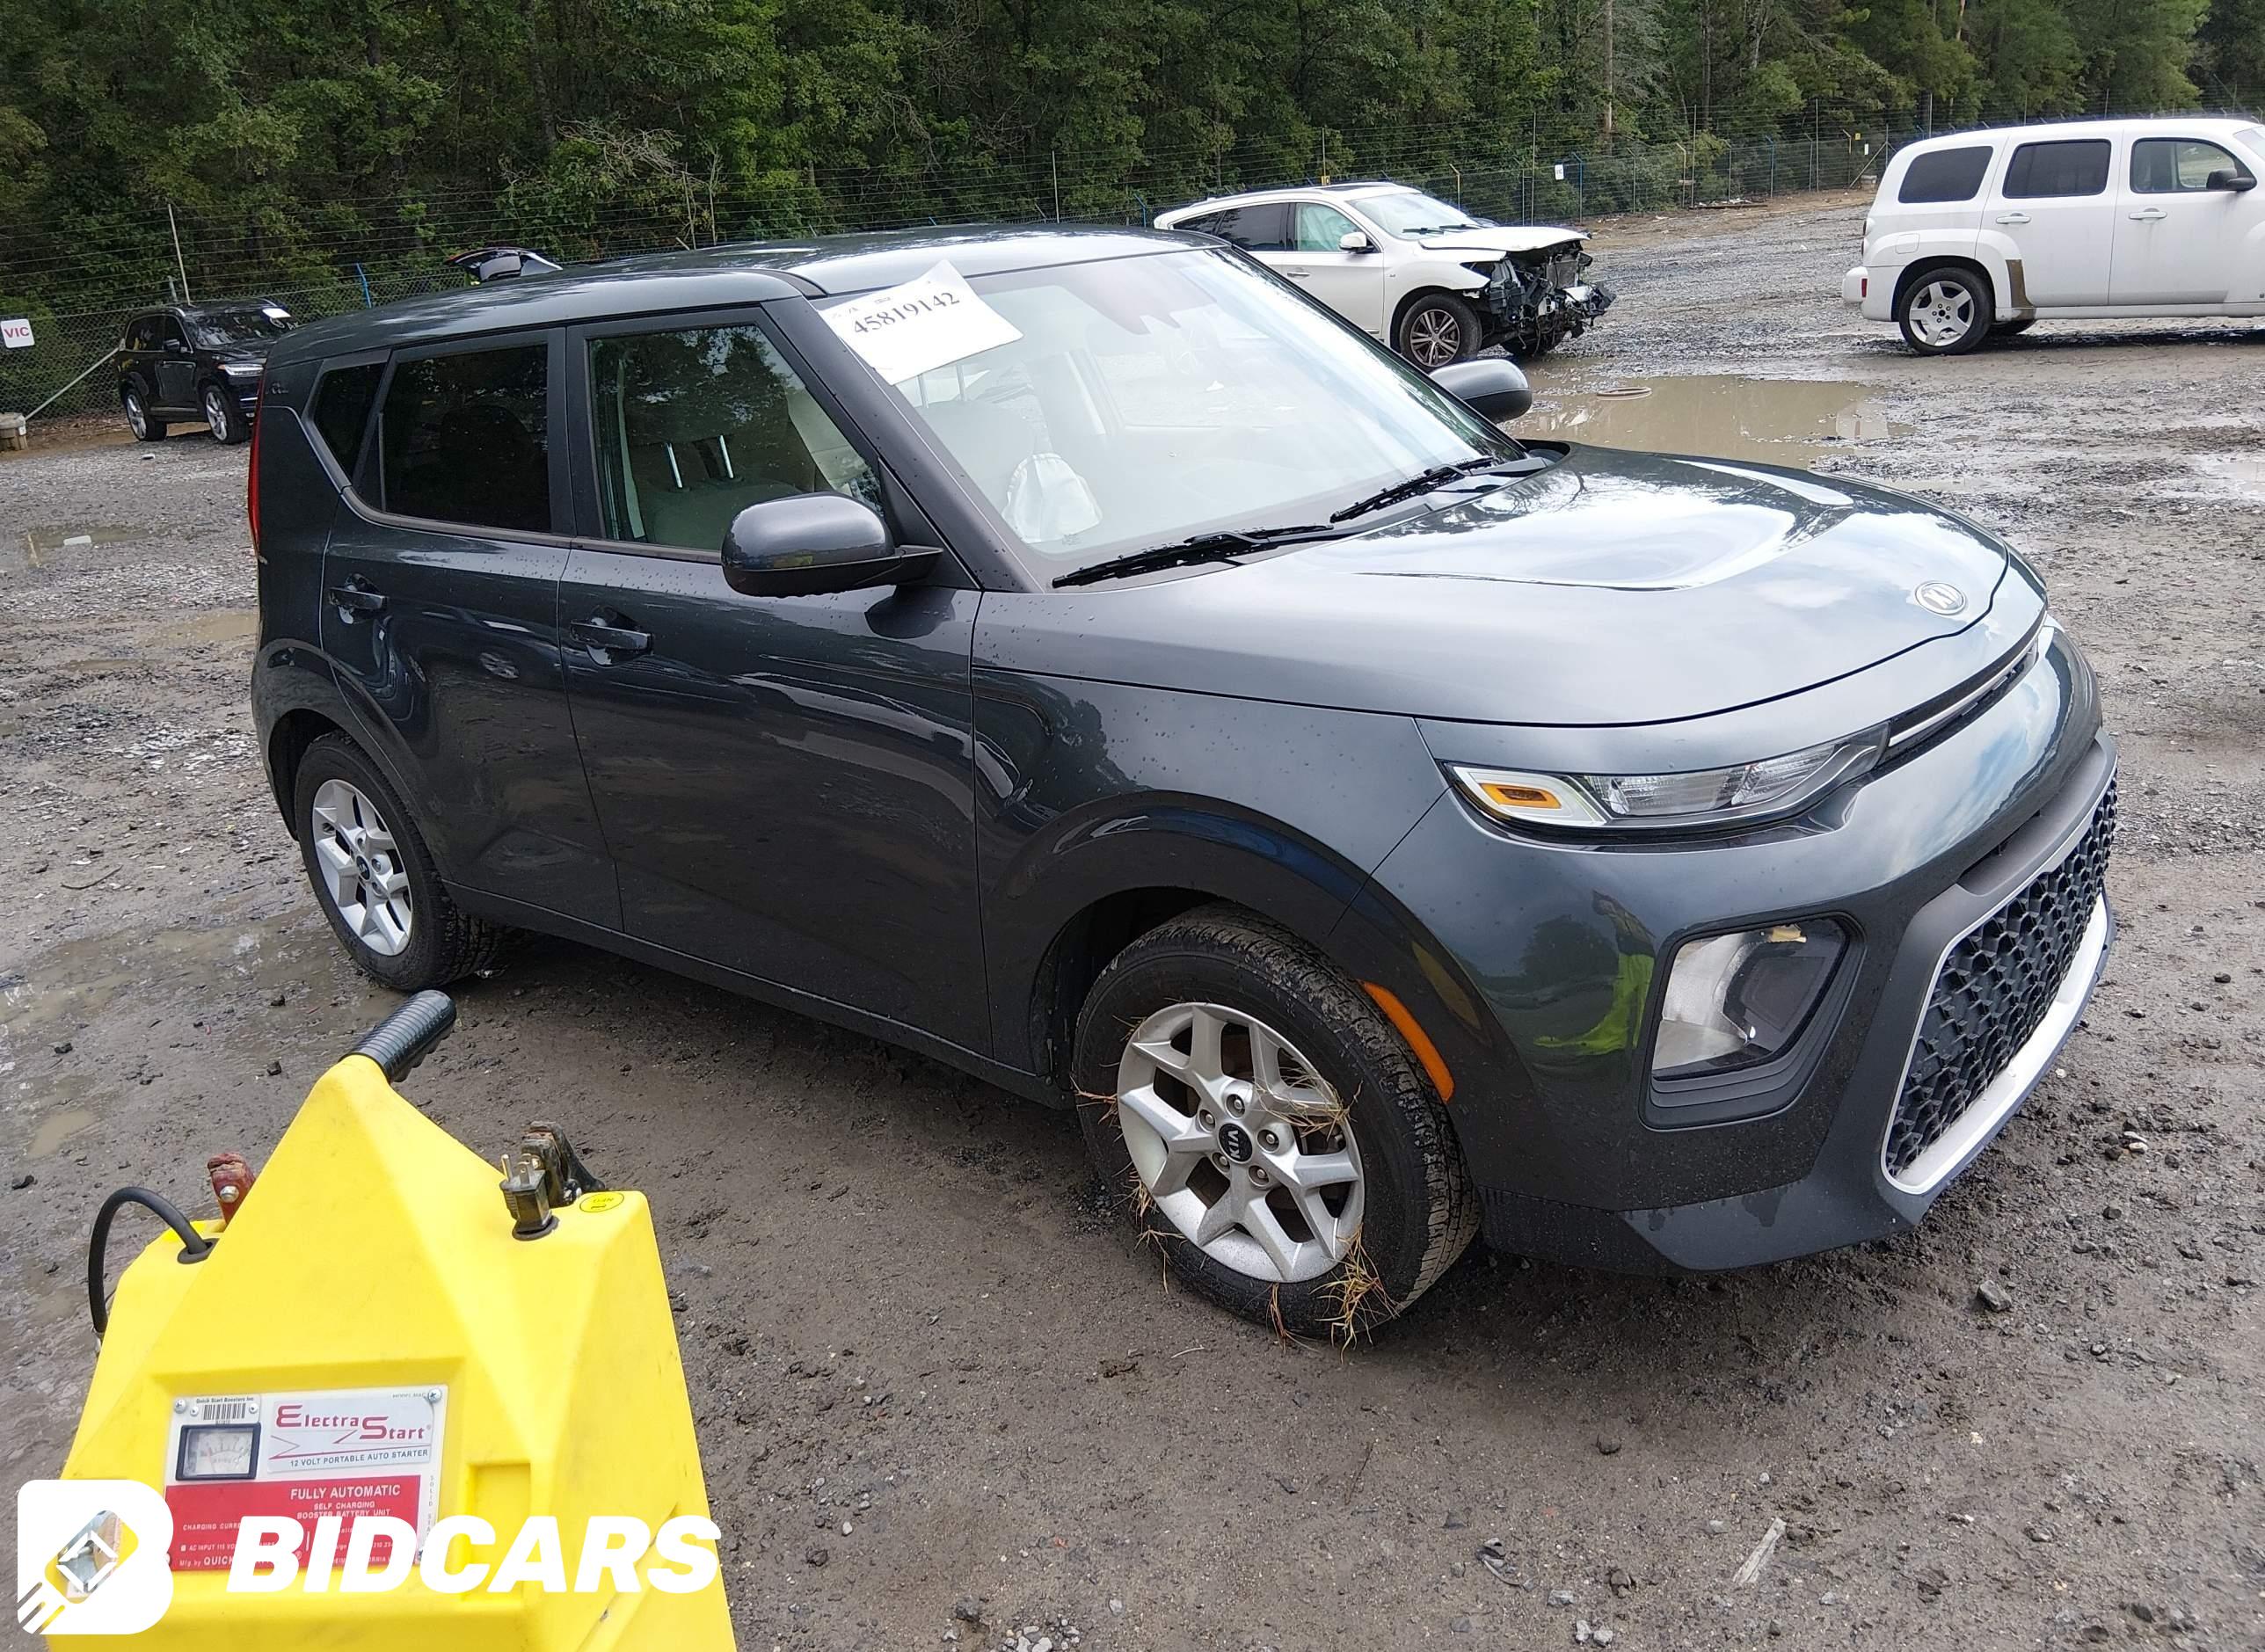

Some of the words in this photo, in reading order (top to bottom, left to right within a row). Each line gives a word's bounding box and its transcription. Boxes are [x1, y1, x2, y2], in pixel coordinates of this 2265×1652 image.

[854, 292, 960, 333] 45819142
[4, 326, 30, 338] VIC
[1228, 1130, 1241, 1160] KIA
[276, 1404, 359, 1428] Electra
[301, 1458, 321, 1466] VOLT
[324, 1454, 365, 1465] PORTABLE
[368, 1452, 390, 1461] AUTO
[391, 1449, 428, 1459] STARTER
[290, 1487, 327, 1500] FULLY
[330, 1484, 401, 1498] AUTOMATIC
[296, 1510, 333, 1519] BOOSTER
[373, 1508, 390, 1517] UNIT
[336, 1501, 375, 1510] CHARGING
